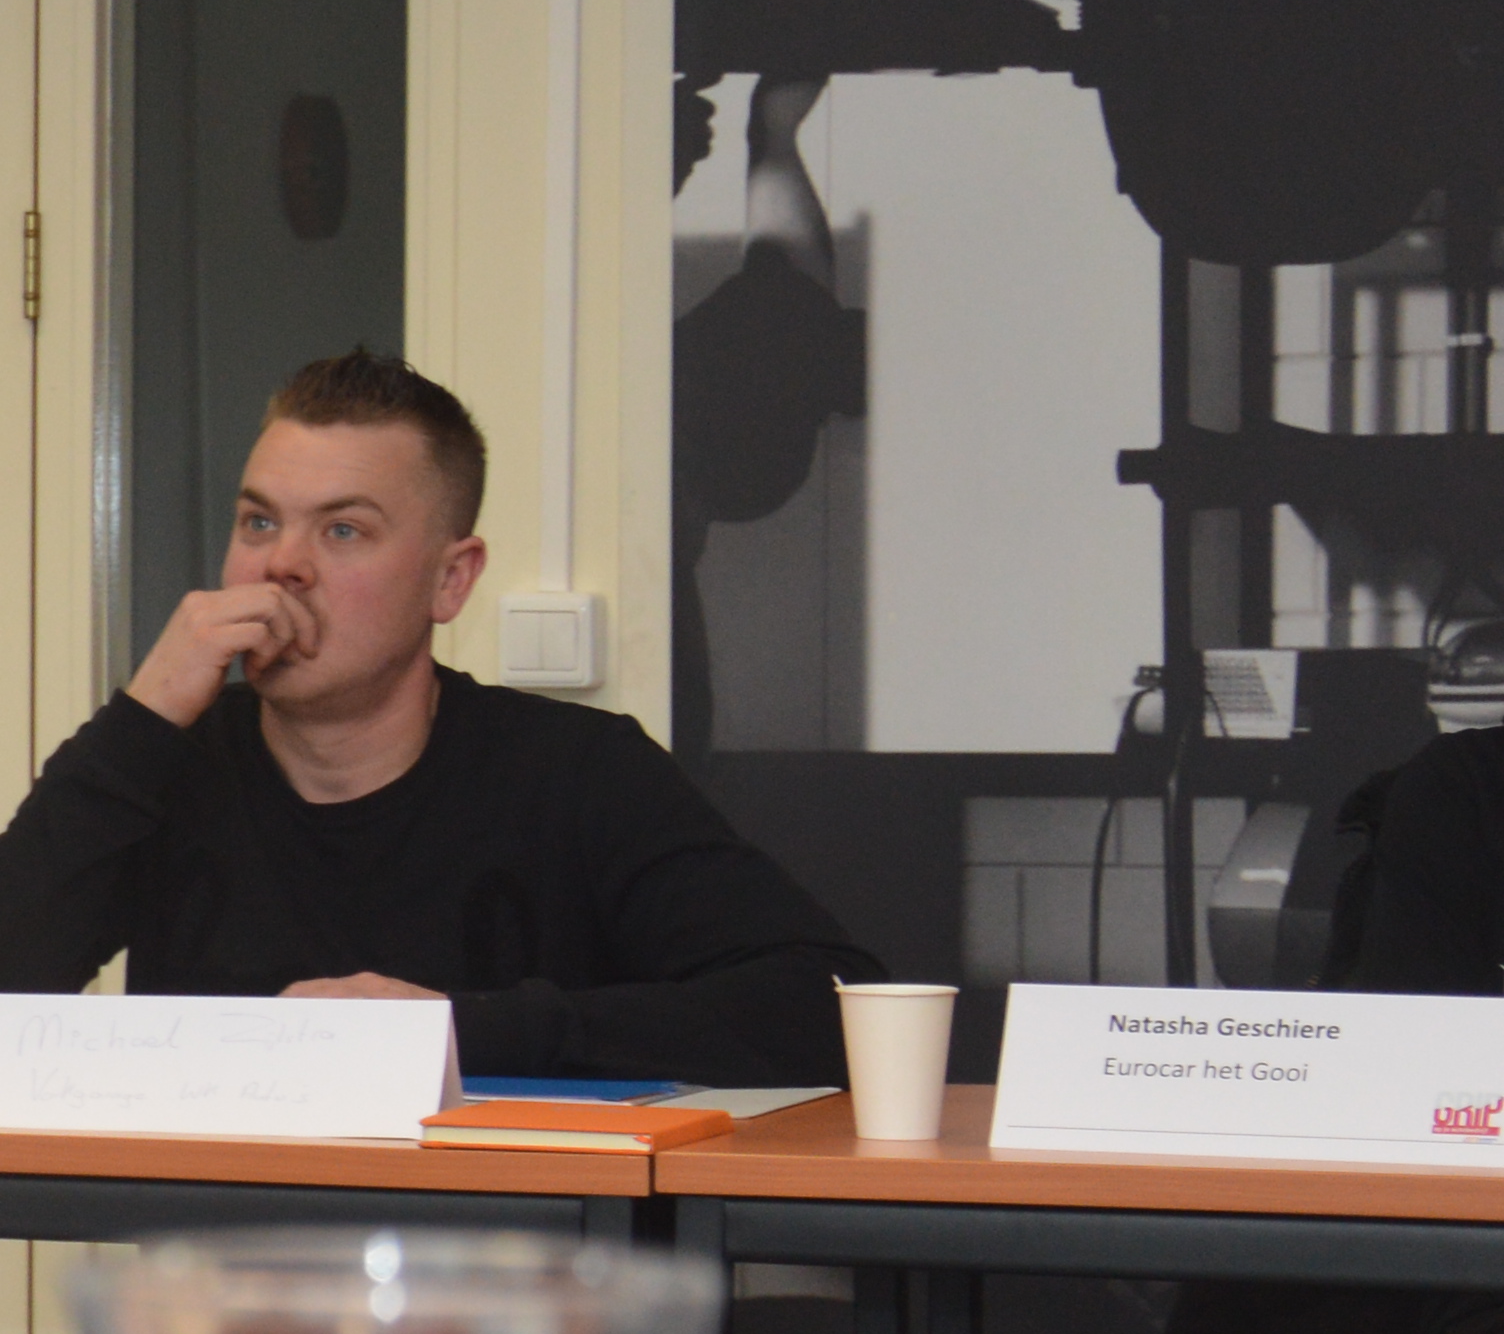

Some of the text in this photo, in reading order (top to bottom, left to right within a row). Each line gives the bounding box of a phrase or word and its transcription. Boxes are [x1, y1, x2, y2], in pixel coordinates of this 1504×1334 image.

[17, 1013, 181, 1057] Michael
[1108, 1014, 1342, 1040] Natasha Geschiere
[1103, 1056, 1309, 1082] Eurocar het Gooi
